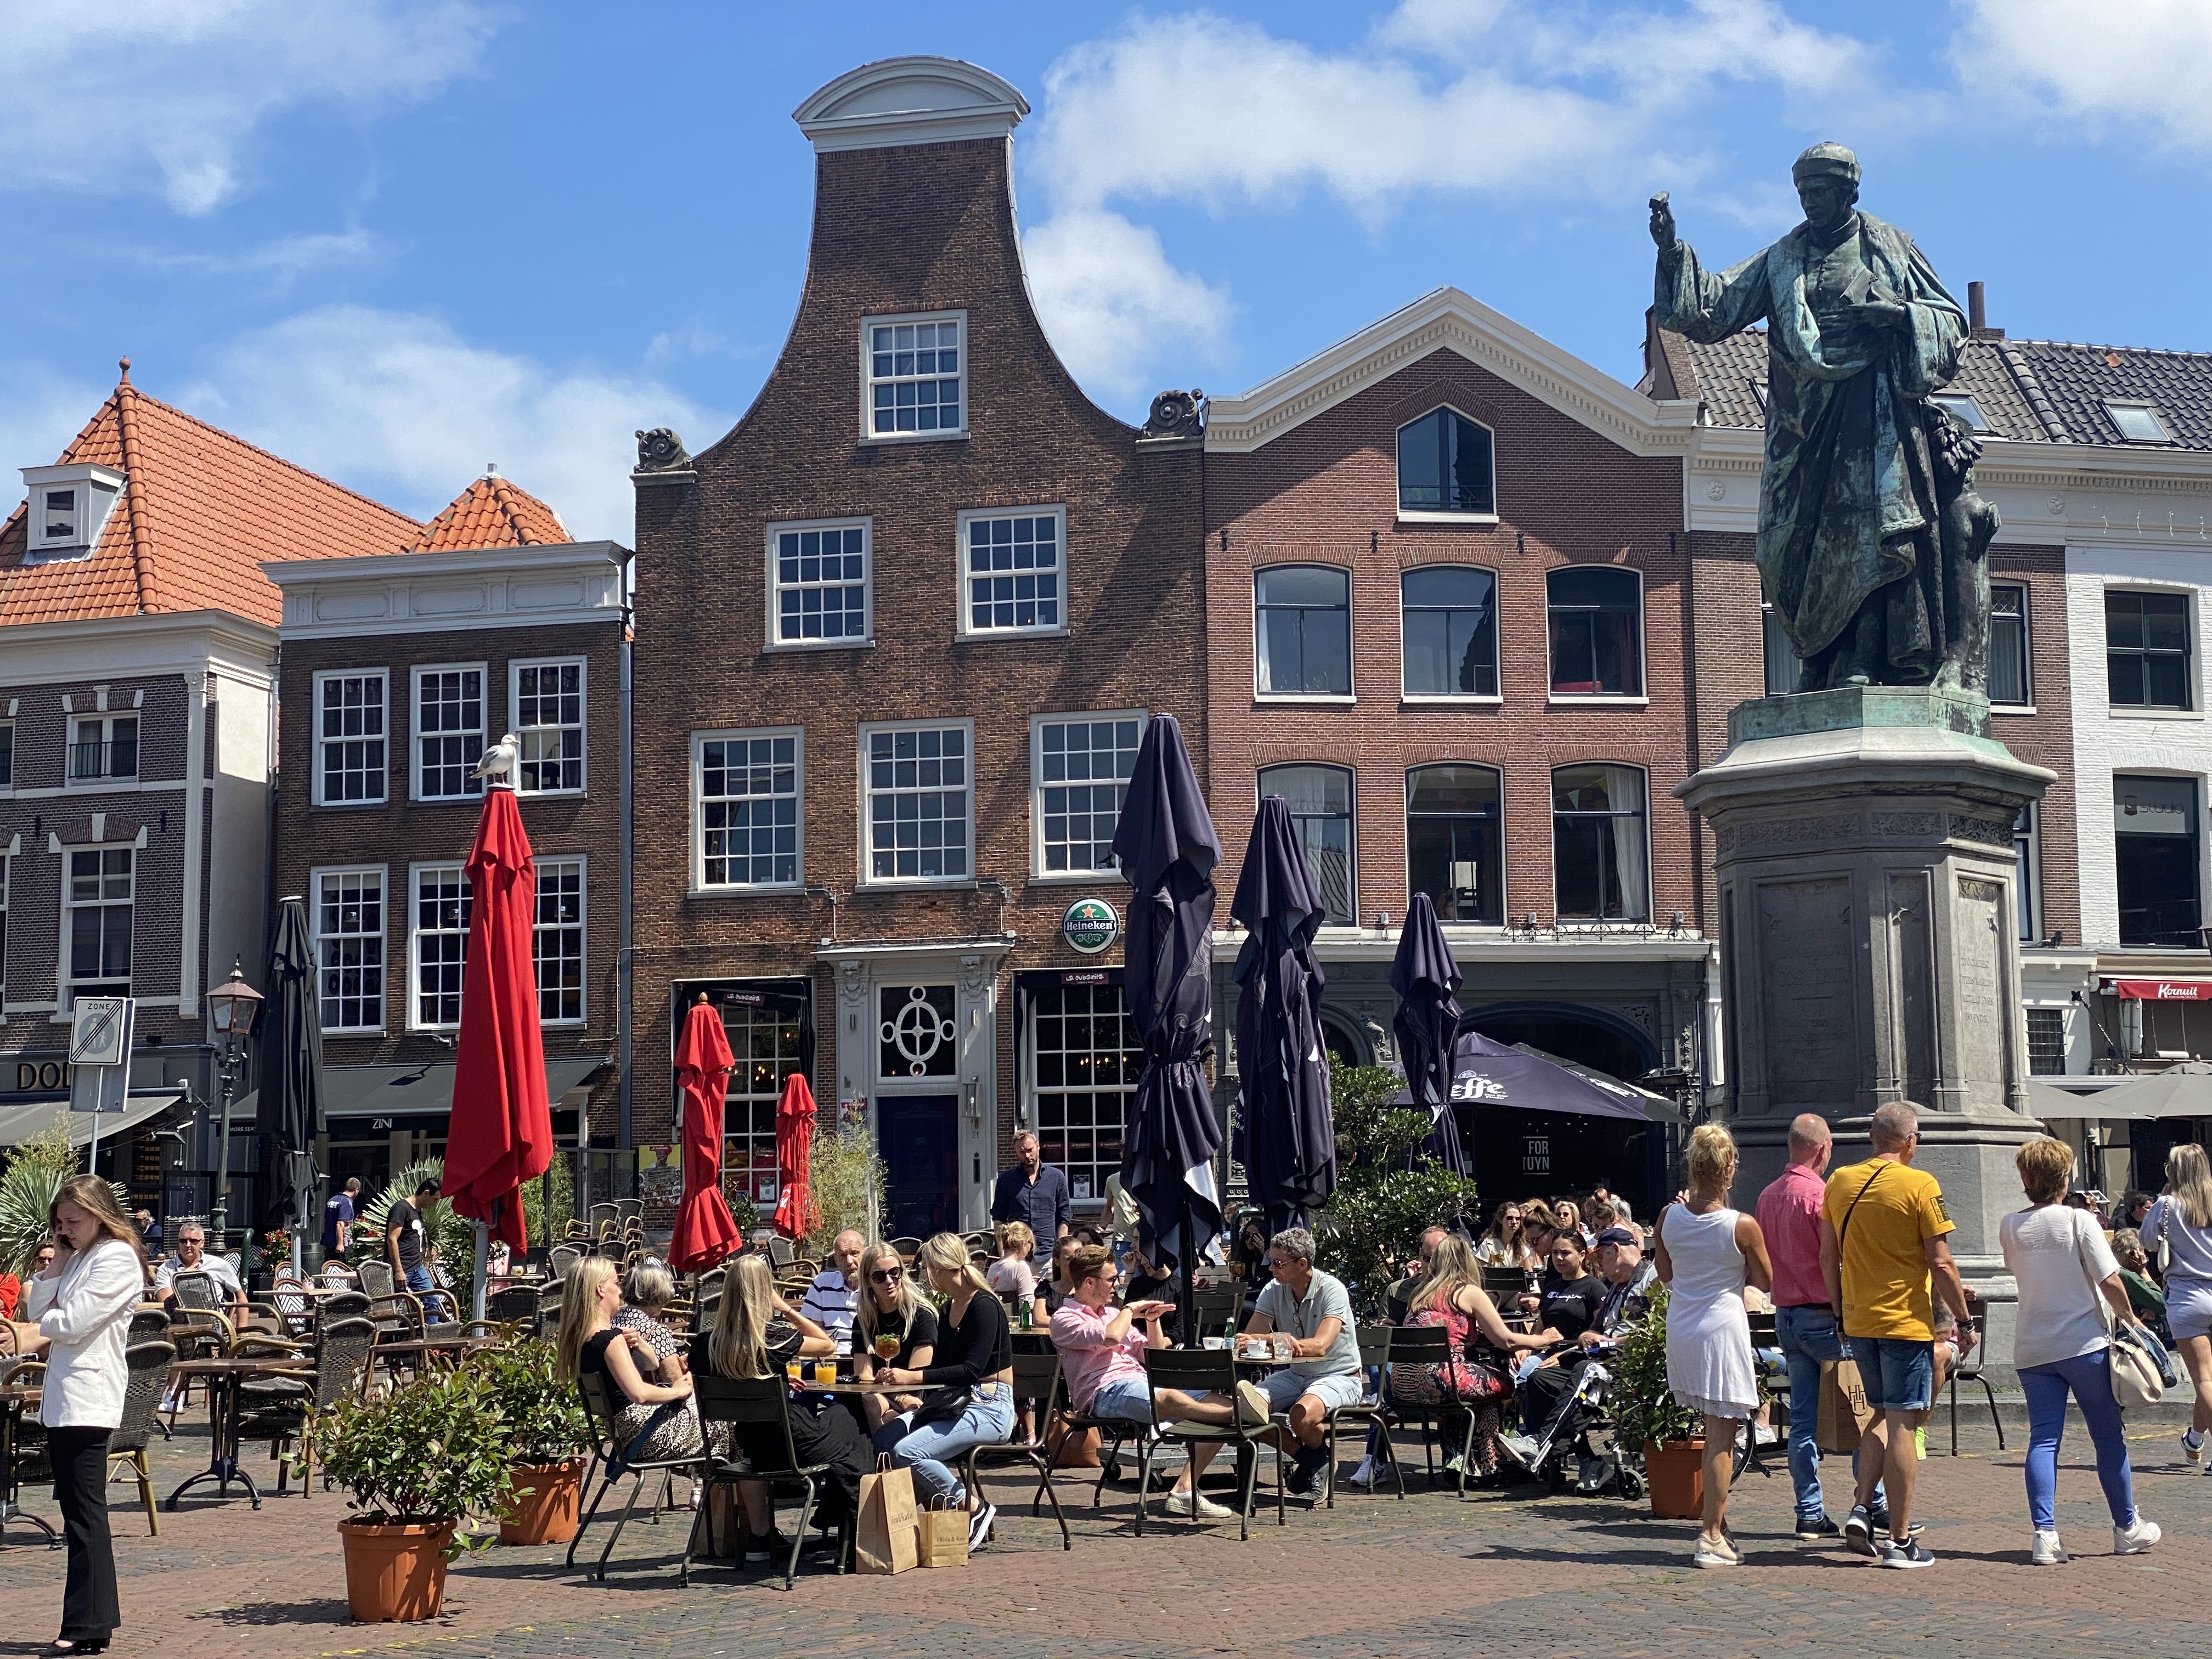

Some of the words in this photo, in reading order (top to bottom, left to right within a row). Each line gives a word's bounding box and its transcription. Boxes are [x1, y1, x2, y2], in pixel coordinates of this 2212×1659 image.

[1066, 921, 1113, 931] Heineken
[2158, 984, 2198, 998] Kornuit
[1451, 1077, 1504, 1099] effe
[1528, 1141, 1549, 1154] FOR
